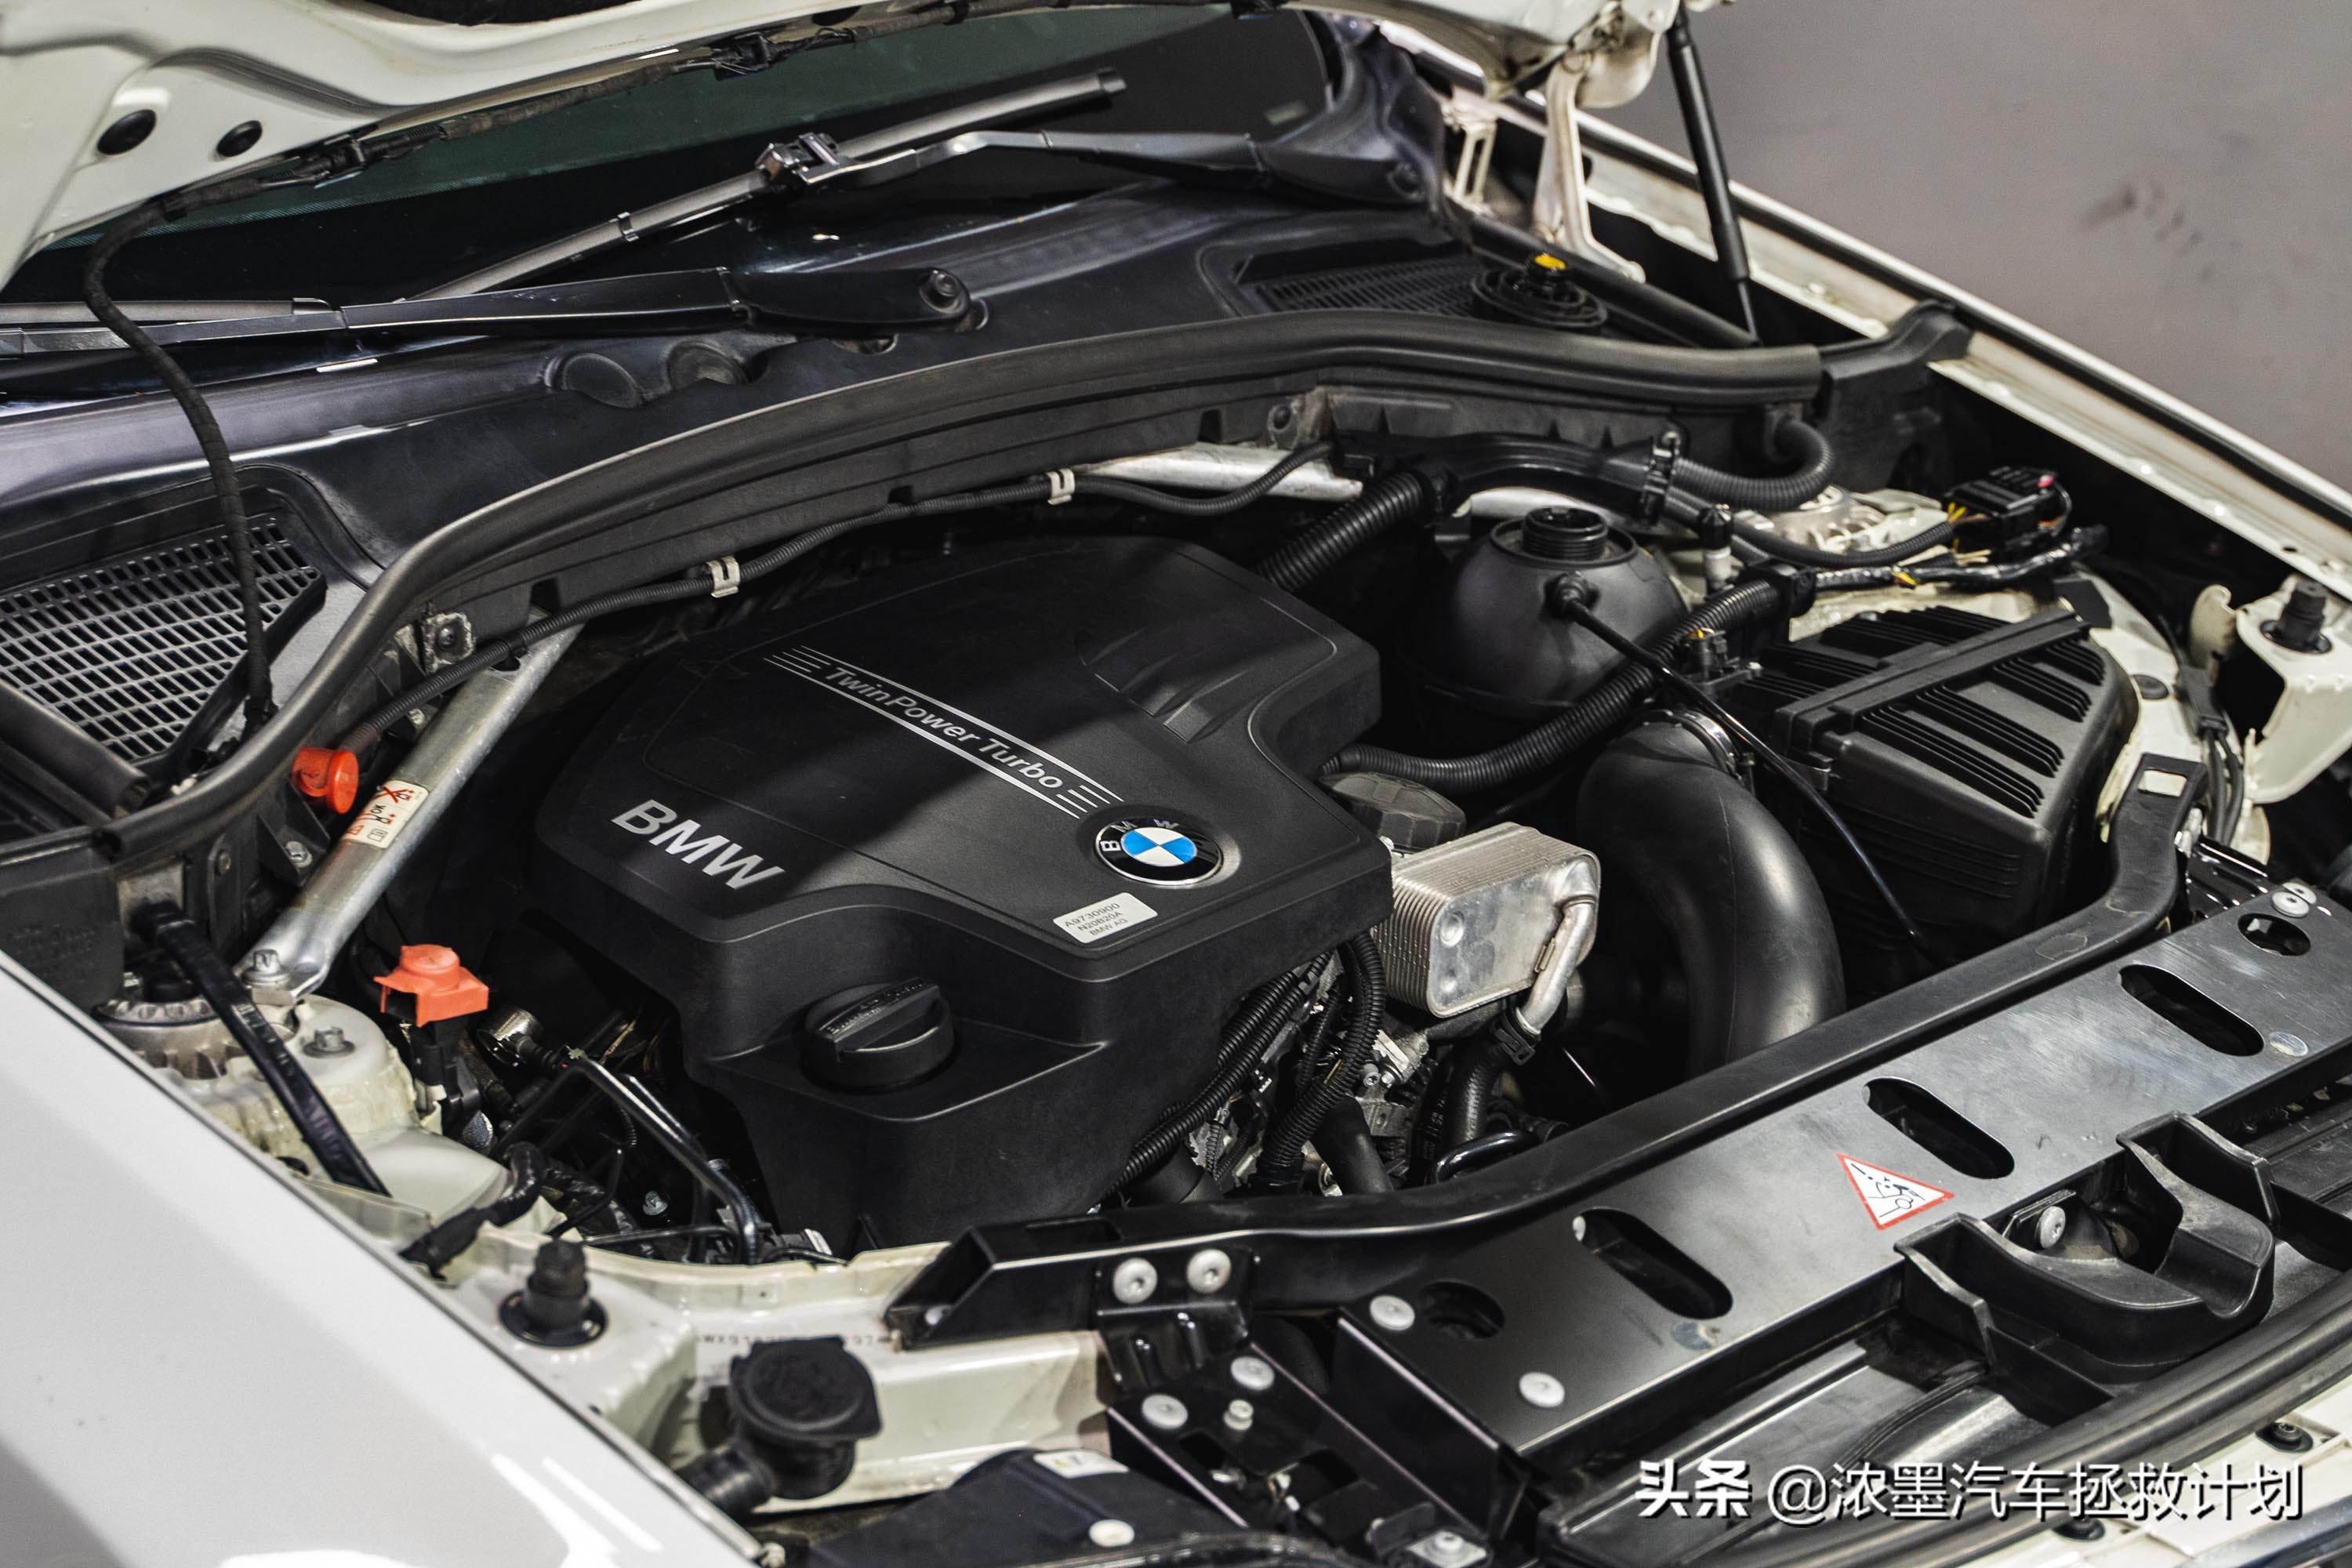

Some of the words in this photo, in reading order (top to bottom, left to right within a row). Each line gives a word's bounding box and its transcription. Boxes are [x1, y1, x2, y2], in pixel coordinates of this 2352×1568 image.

[826, 667, 981, 742] TwinPower
[979, 738, 1063, 788] Turbo
[611, 799, 786, 890] BMW
[1099, 818, 1180, 852] BMW
[1077, 910, 1124, 932] N20B20A
[1090, 922, 1114, 936] BMW
[1114, 918, 1129, 927] AG
